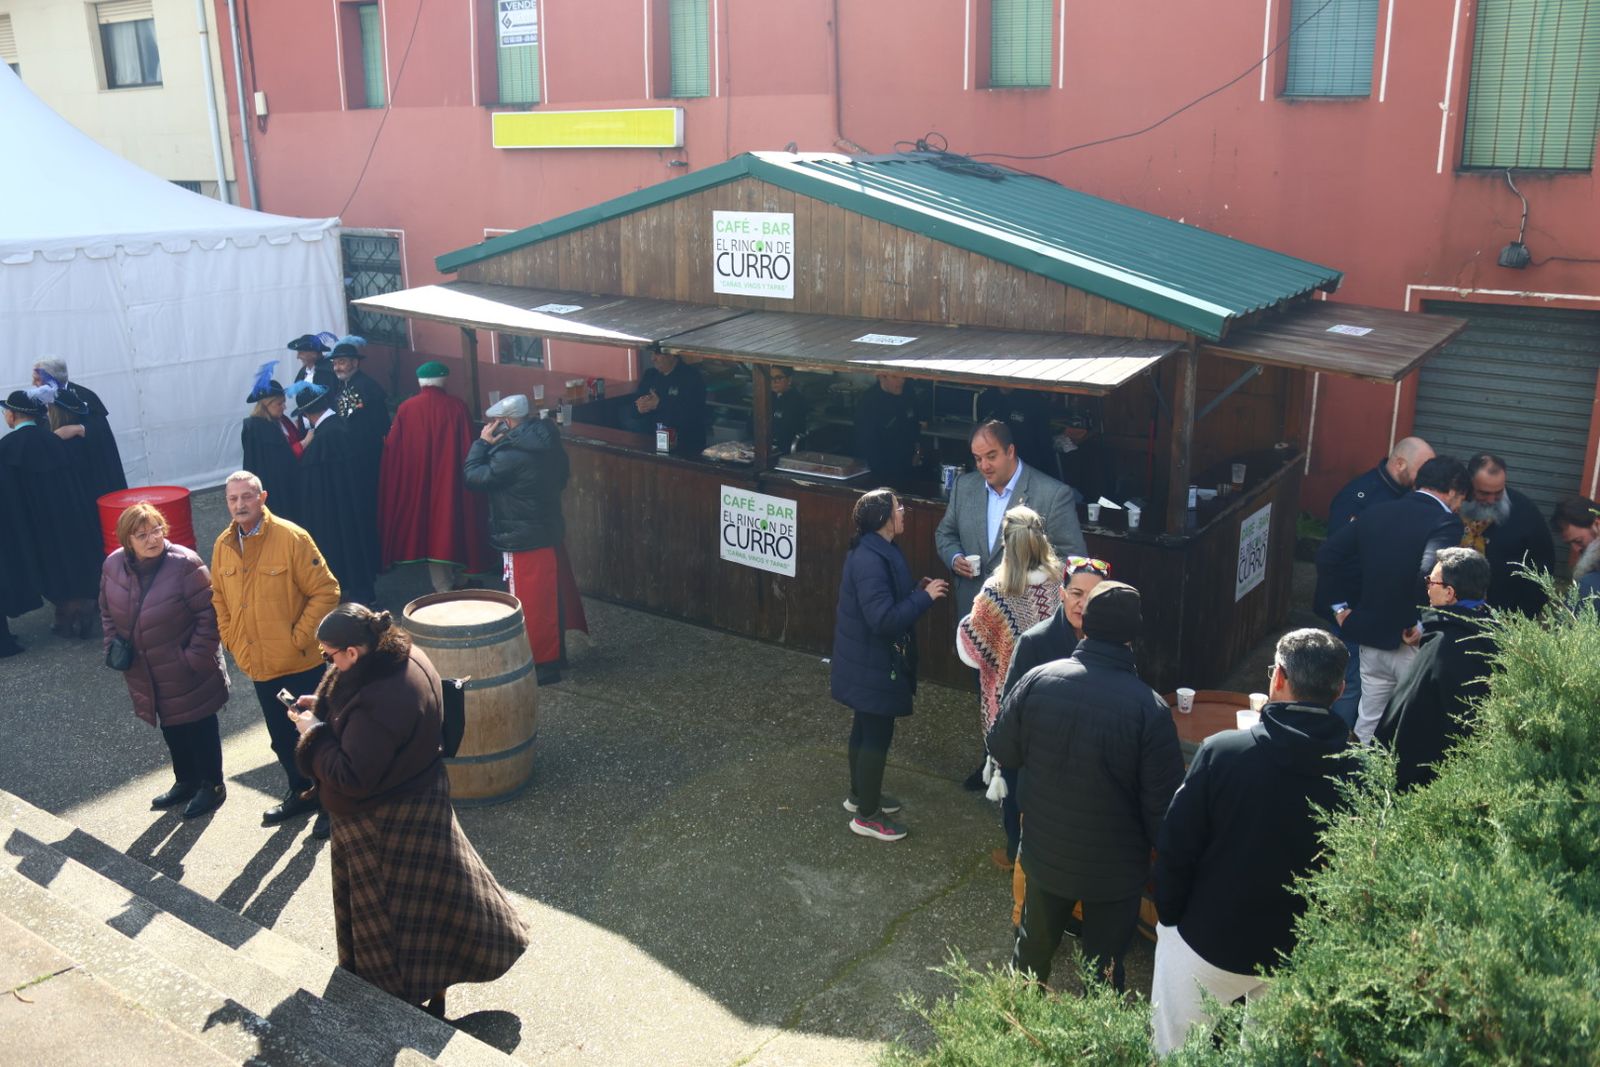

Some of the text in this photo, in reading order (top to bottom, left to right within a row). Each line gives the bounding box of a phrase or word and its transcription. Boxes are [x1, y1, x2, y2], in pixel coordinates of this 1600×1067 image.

[505, 0, 537, 11] VENDE
[716, 218, 750, 234] CAFÉ
[762, 221, 791, 236] BAR
[716, 238, 728, 251] EL
[776, 241, 791, 255] DE
[716, 251, 791, 281] CURRO
[723, 494, 756, 512] CAFÉ
[766, 503, 794, 521] BAR
[723, 510, 734, 524] EL
[780, 523, 794, 538] DE
[723, 523, 793, 560] CURRO
[1238, 543, 1267, 584] CURRO
